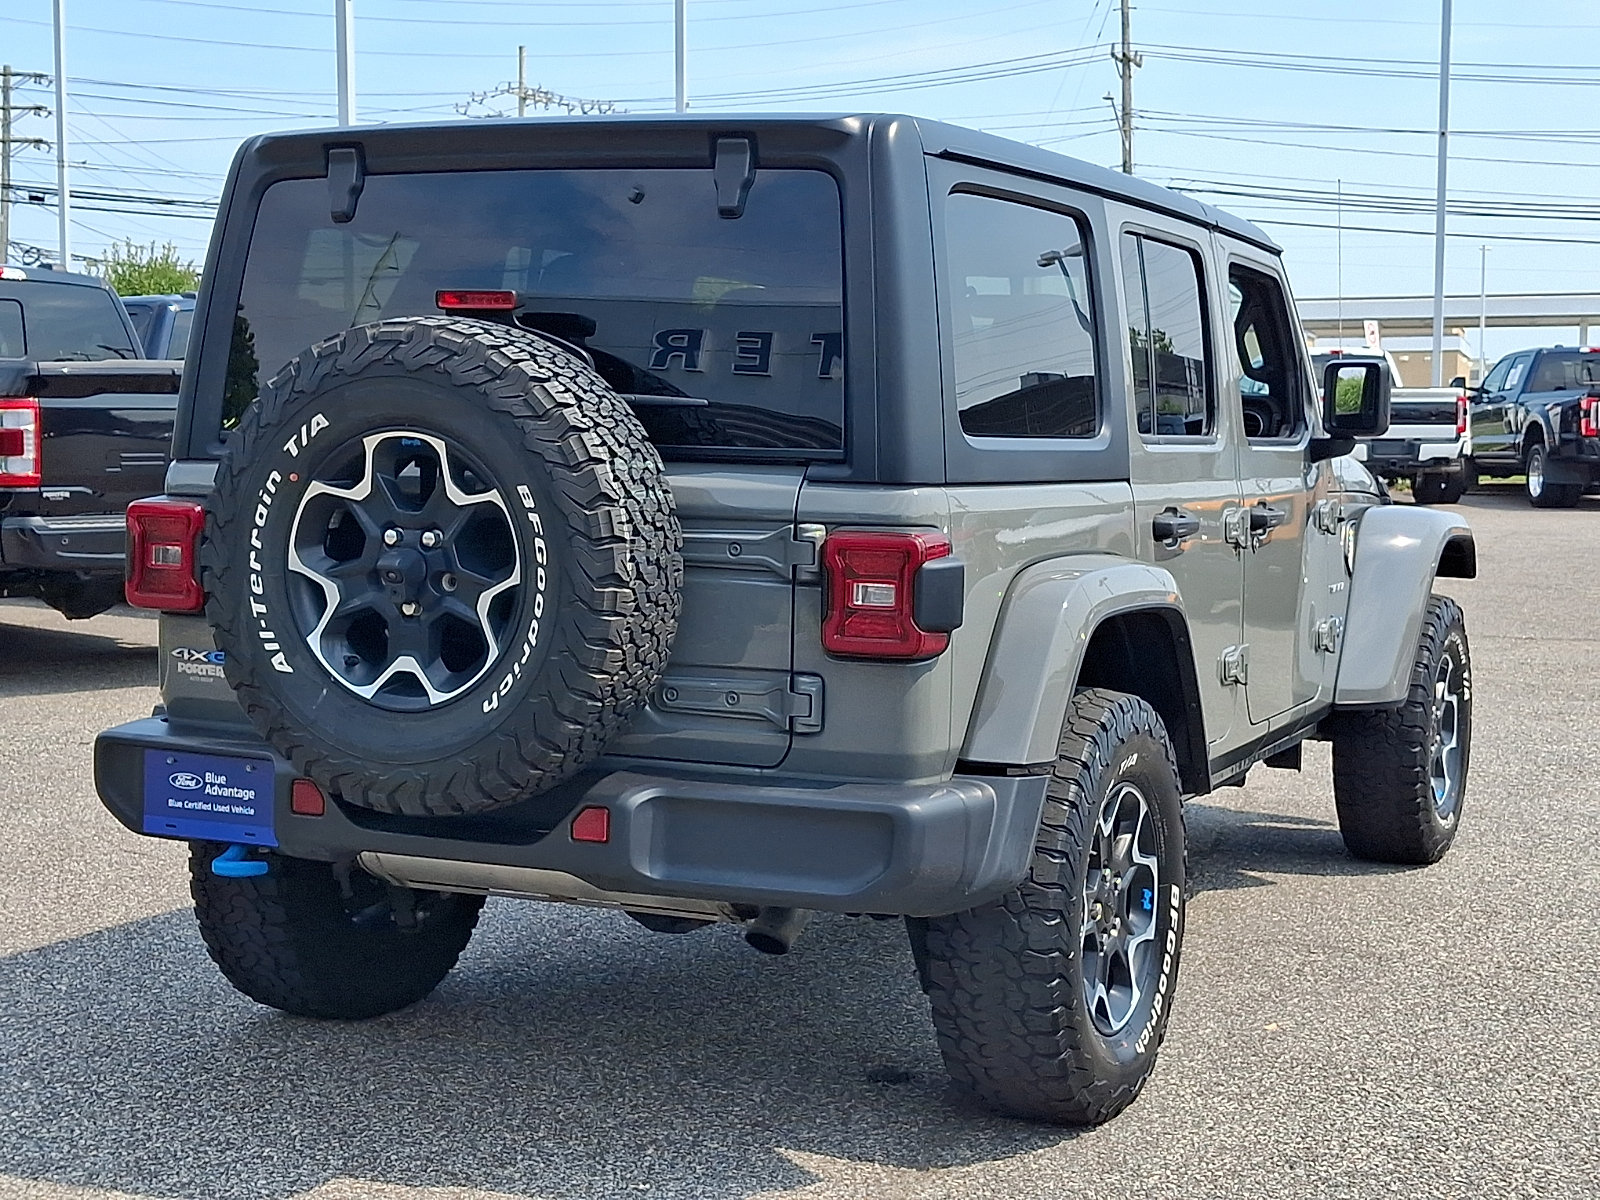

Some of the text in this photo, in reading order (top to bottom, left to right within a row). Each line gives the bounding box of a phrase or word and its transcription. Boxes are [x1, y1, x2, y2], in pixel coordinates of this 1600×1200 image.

[283, 413, 330, 458] T/A
[250, 470, 294, 674] All-Terrain
[482, 484, 547, 713] BFGoodrich
[177, 661, 225, 678] PORTER
[204, 784, 255, 801] Advantage
[205, 772, 227, 785] Blue
[168, 799, 255, 816] Blue Certified Used Vehicle
[1135, 884, 1180, 1054] BFGoodrich
